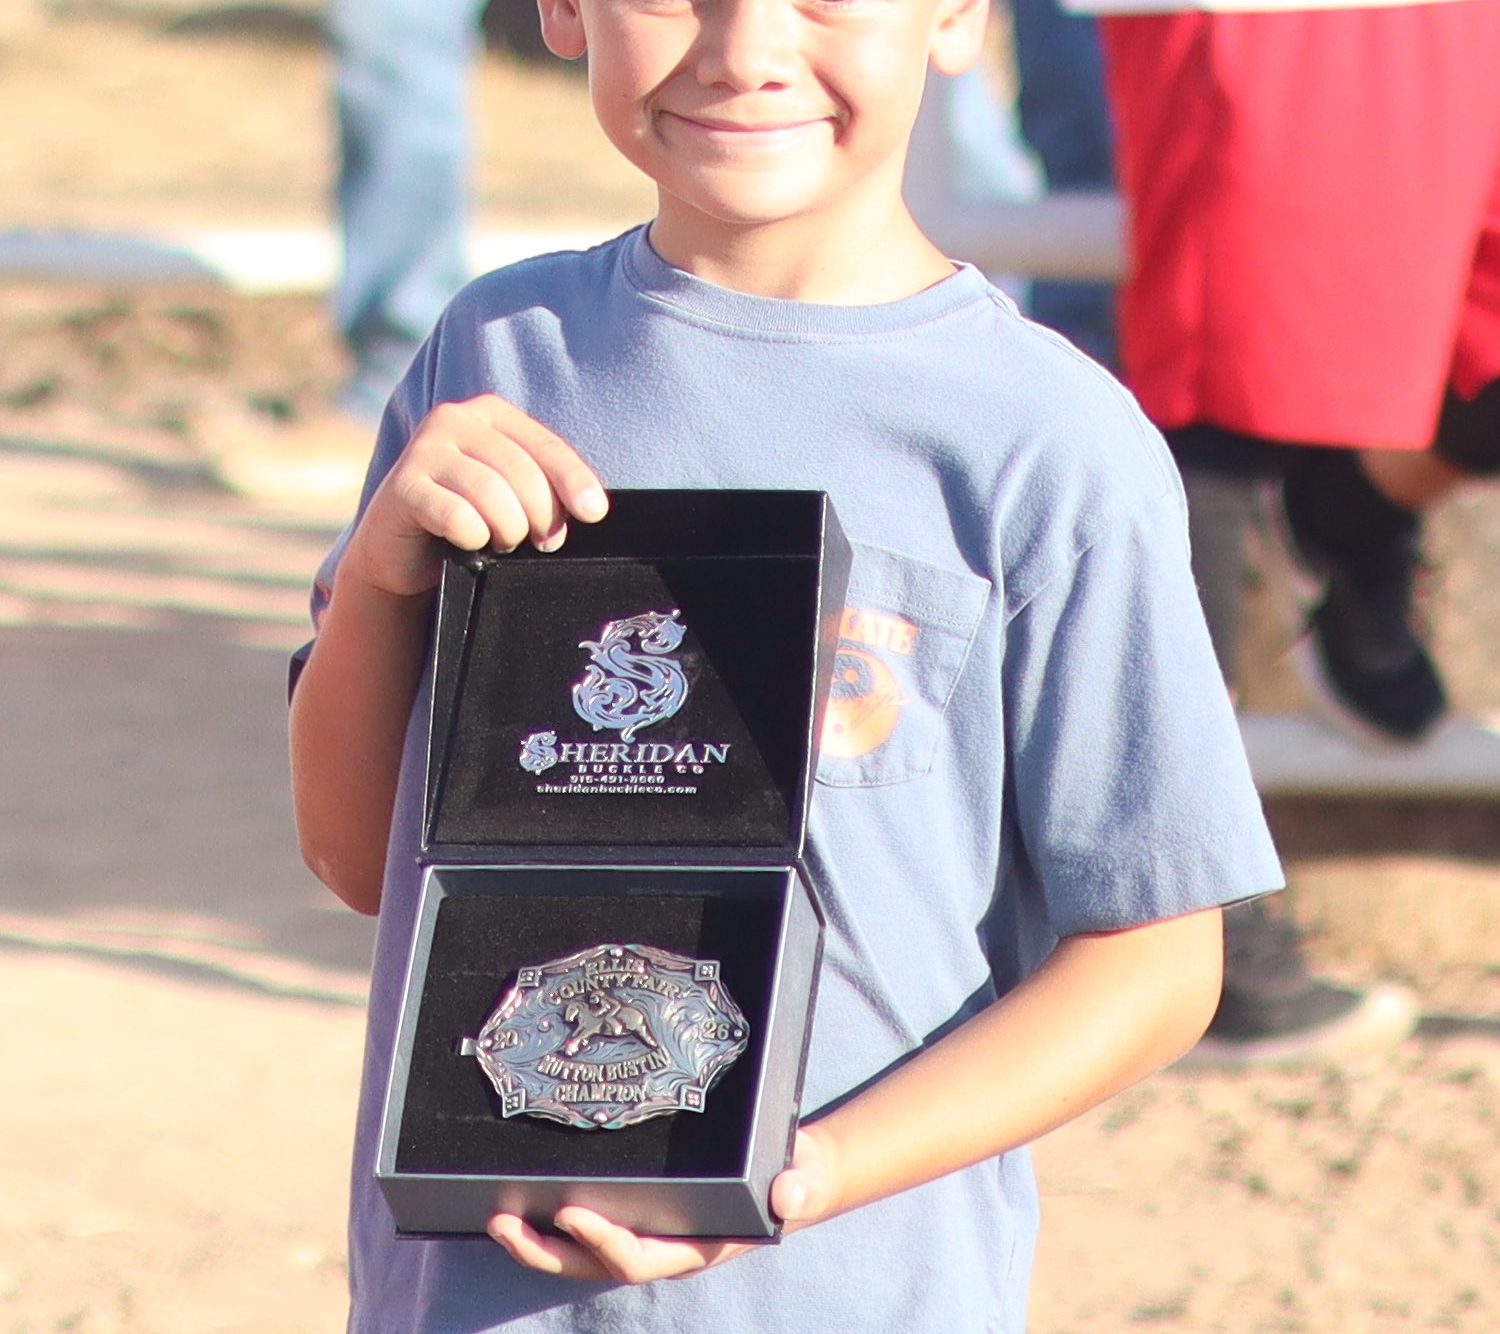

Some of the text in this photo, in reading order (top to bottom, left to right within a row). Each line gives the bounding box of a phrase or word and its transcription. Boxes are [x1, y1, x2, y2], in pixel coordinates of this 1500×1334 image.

[519, 731, 732, 775] SHERIDAN
[578, 764, 705, 775] BUCKLE CO
[536, 783, 698, 795] sheridanbuckleco.com
[584, 958, 646, 975] ELLIS
[549, 972, 681, 1005] COUNTY FAIR
[493, 1021, 730, 1050] 20 26
[537, 1053, 604, 1083] MUTTON
[554, 1079, 648, 1103] CHAMPION
